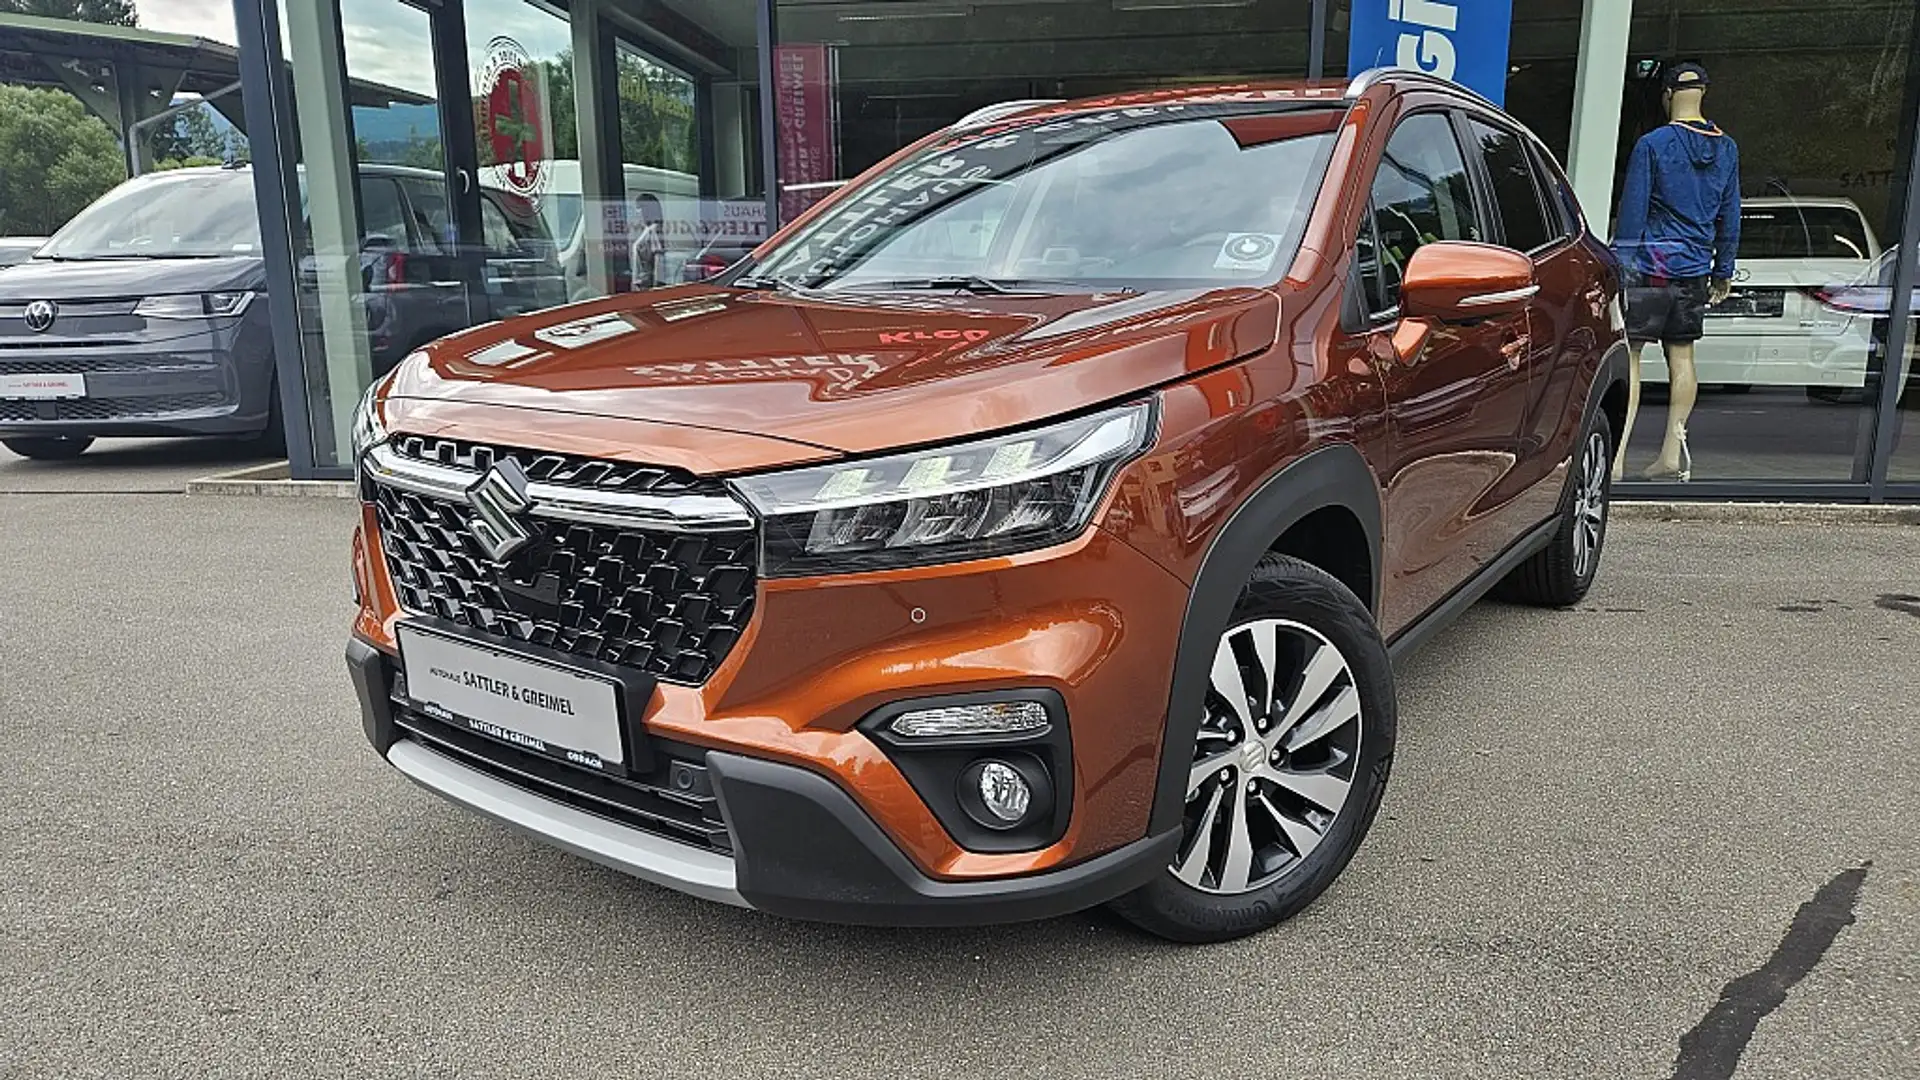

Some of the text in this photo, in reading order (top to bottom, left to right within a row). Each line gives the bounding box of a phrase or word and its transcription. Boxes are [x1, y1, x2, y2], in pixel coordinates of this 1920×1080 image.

[463, 671, 510, 699] SATTLER
[511, 685, 520, 701] &
[521, 688, 576, 716] GREIMEL
